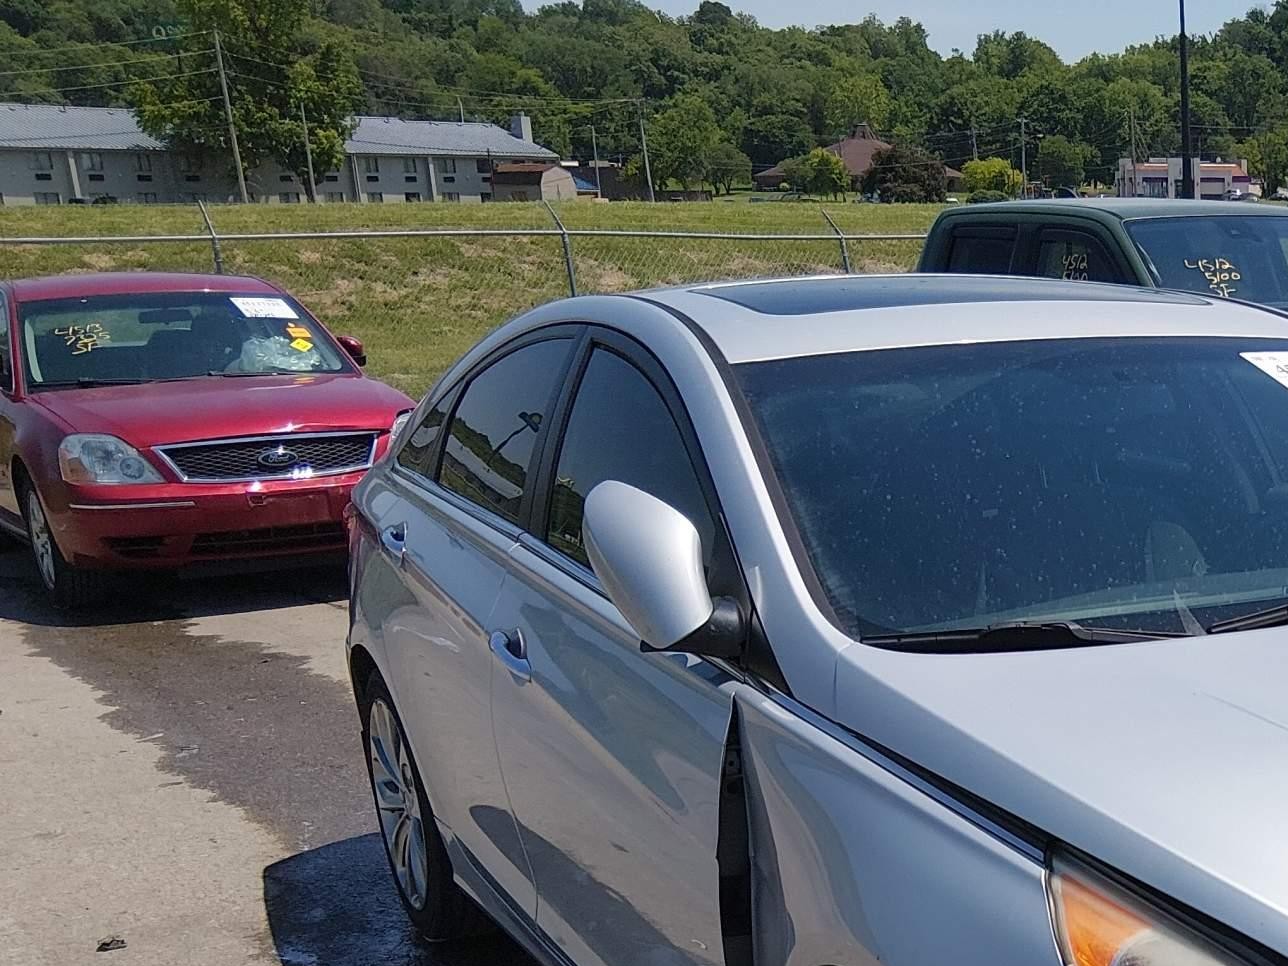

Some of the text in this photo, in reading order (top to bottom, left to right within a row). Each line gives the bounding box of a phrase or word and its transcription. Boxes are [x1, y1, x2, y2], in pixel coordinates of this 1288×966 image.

[1062, 254, 1088, 270] 4512
[1184, 258, 1236, 272] 4512
[1204, 271, 1241, 284] 5100
[54, 323, 103, 336] 4513
